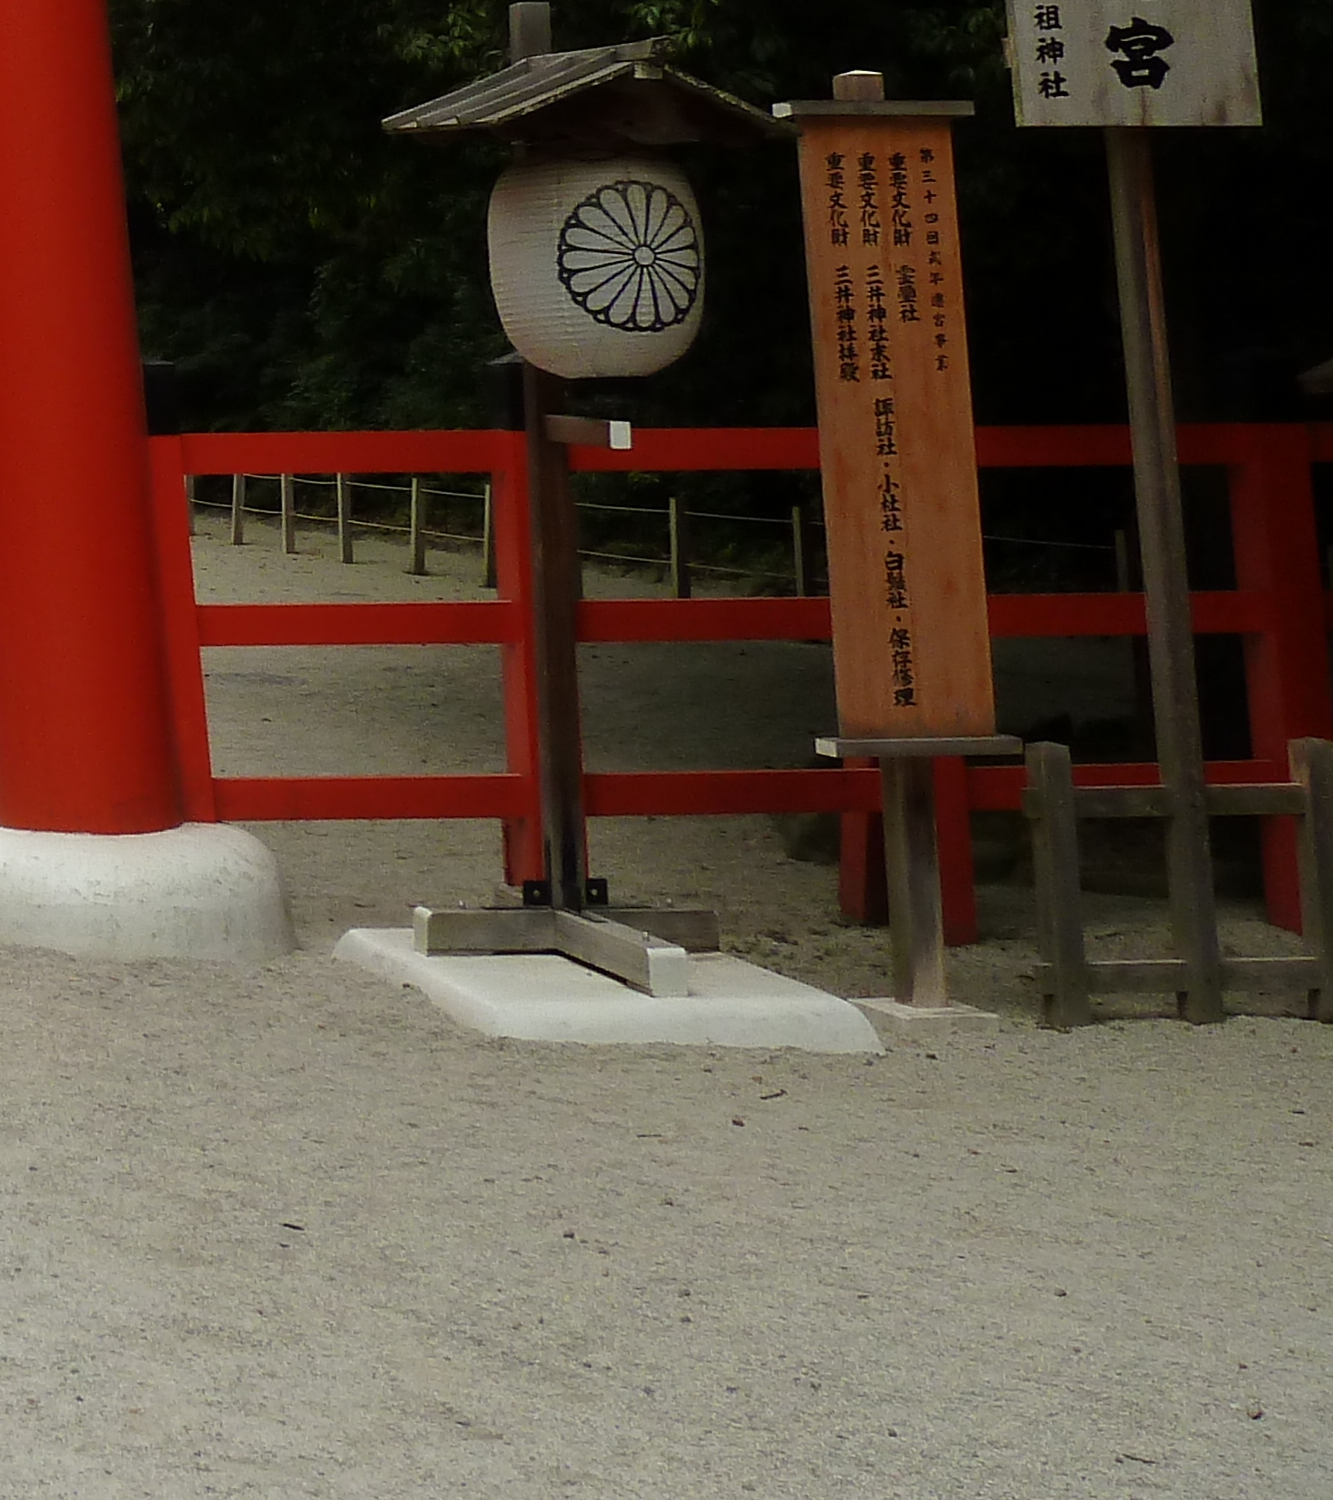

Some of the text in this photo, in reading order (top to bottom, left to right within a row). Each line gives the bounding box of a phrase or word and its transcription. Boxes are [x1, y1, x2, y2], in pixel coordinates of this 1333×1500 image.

[824, 151, 850, 248] 重要文化財
[857, 151, 880, 247] 重要文化財
[888, 151, 911, 248] 重要文化財
[865, 264, 893, 381] 三井神社末社
